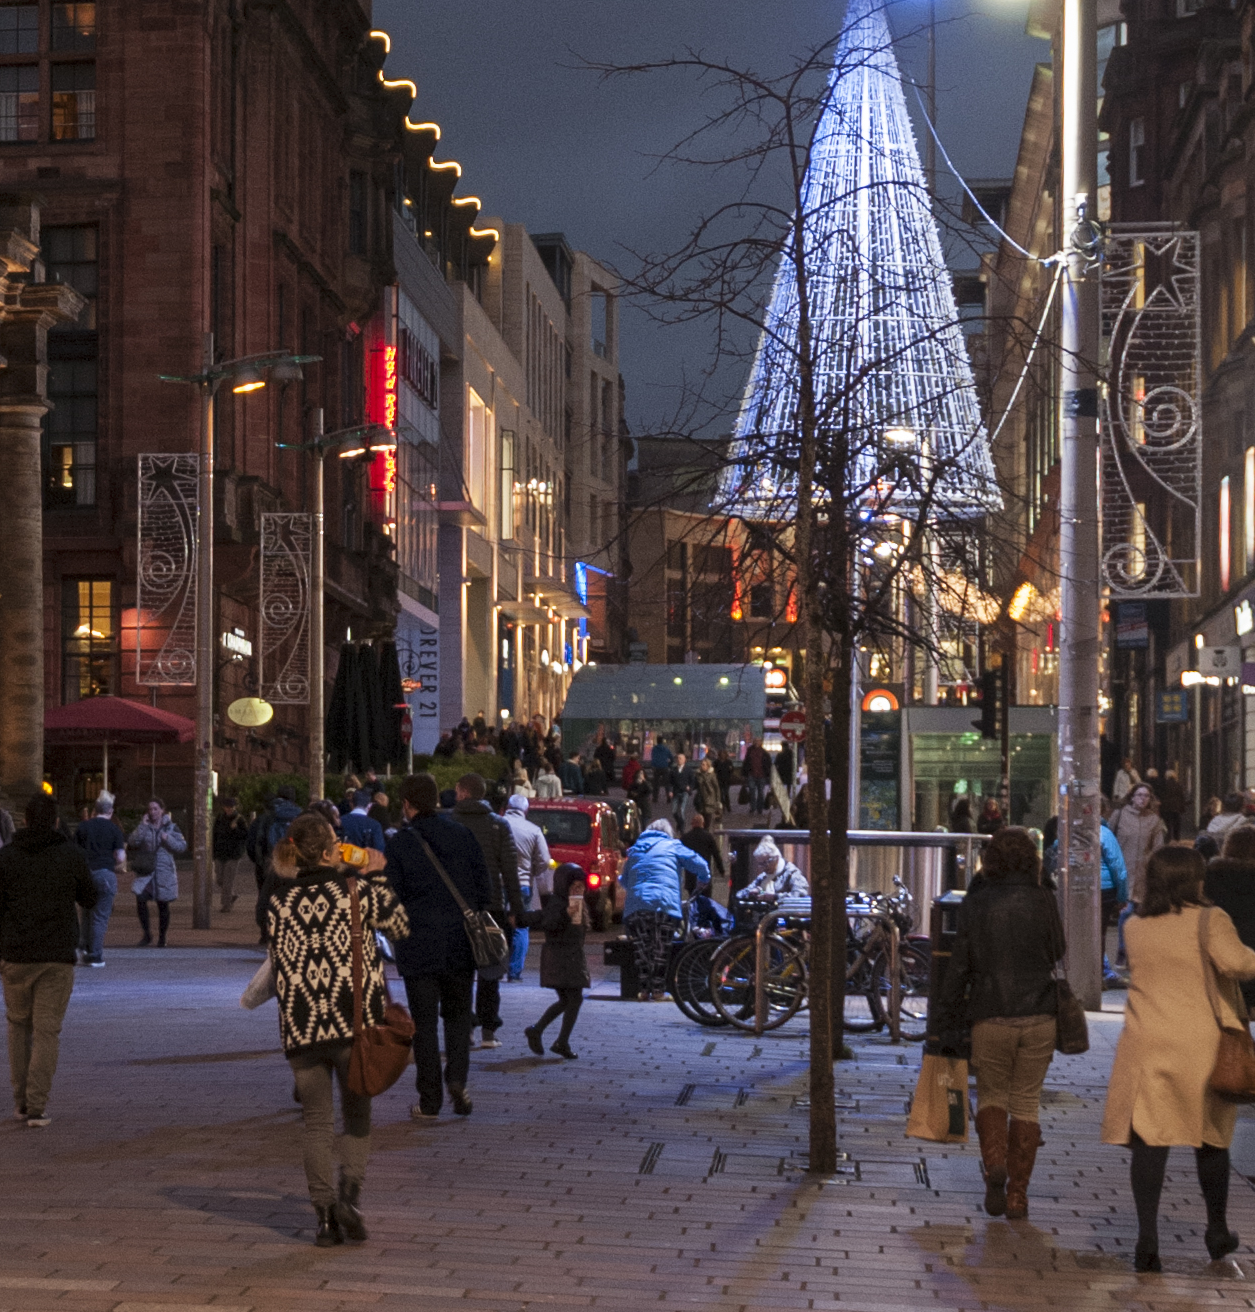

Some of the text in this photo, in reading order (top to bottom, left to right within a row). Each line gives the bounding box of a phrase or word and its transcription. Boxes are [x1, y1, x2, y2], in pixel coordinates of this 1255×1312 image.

[385, 346, 397, 389] Hard
[384, 393, 397, 436] Roc
[419, 628, 438, 717] OREVER 21
